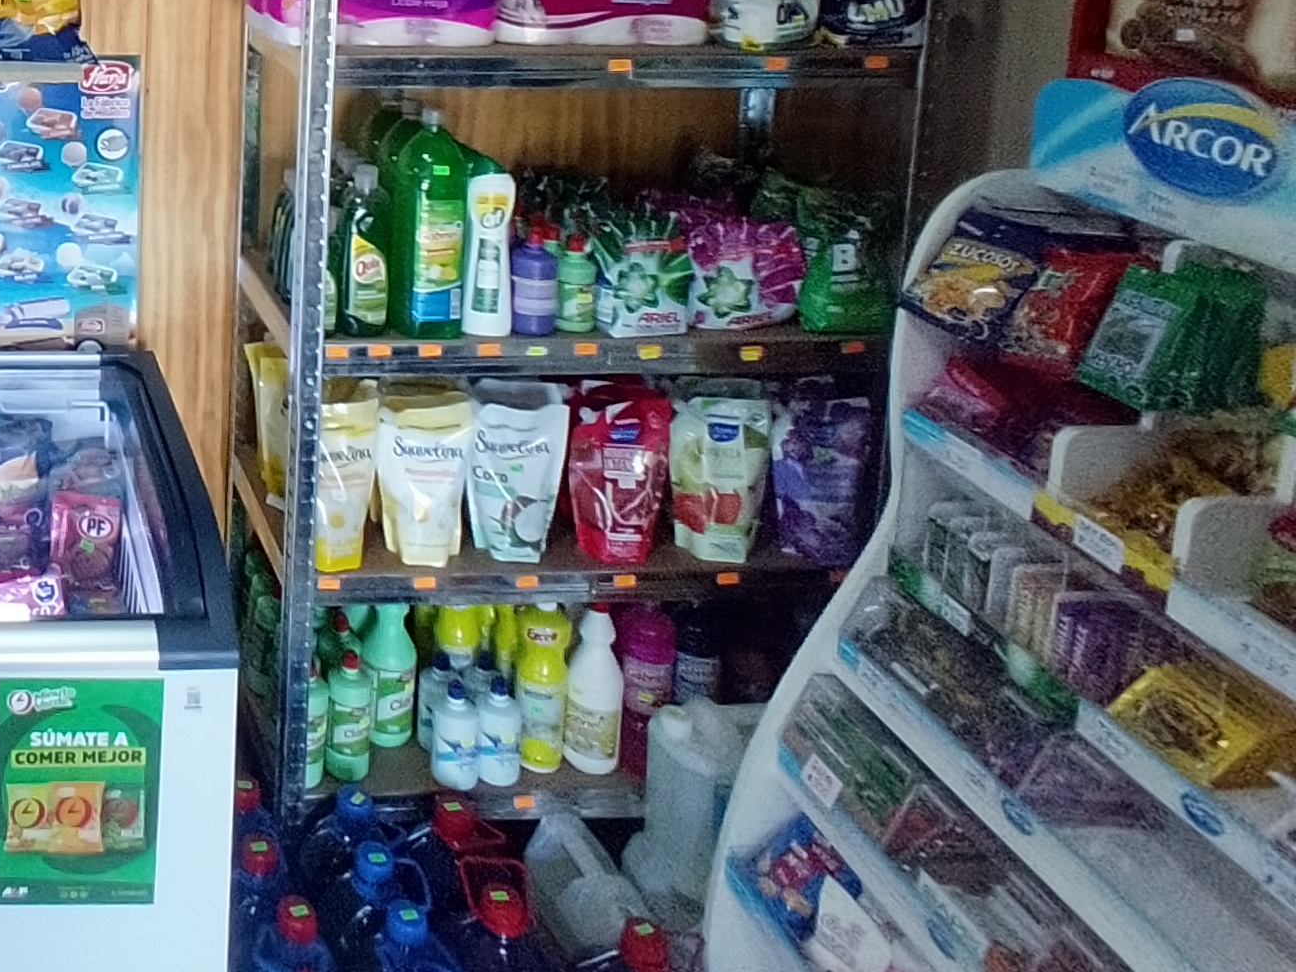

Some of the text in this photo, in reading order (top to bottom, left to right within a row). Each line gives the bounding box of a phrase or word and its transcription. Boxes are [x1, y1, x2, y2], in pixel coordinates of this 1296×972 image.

[1128, 103, 1275, 179] ARCOR
[638, 311, 681, 325] ARIEL
[473, 465, 508, 484] Coco
[86, 517, 107, 536] PF
[30, 728, 129, 747] SÚMATE A
[14, 749, 143, 766] COMER MEJOR
